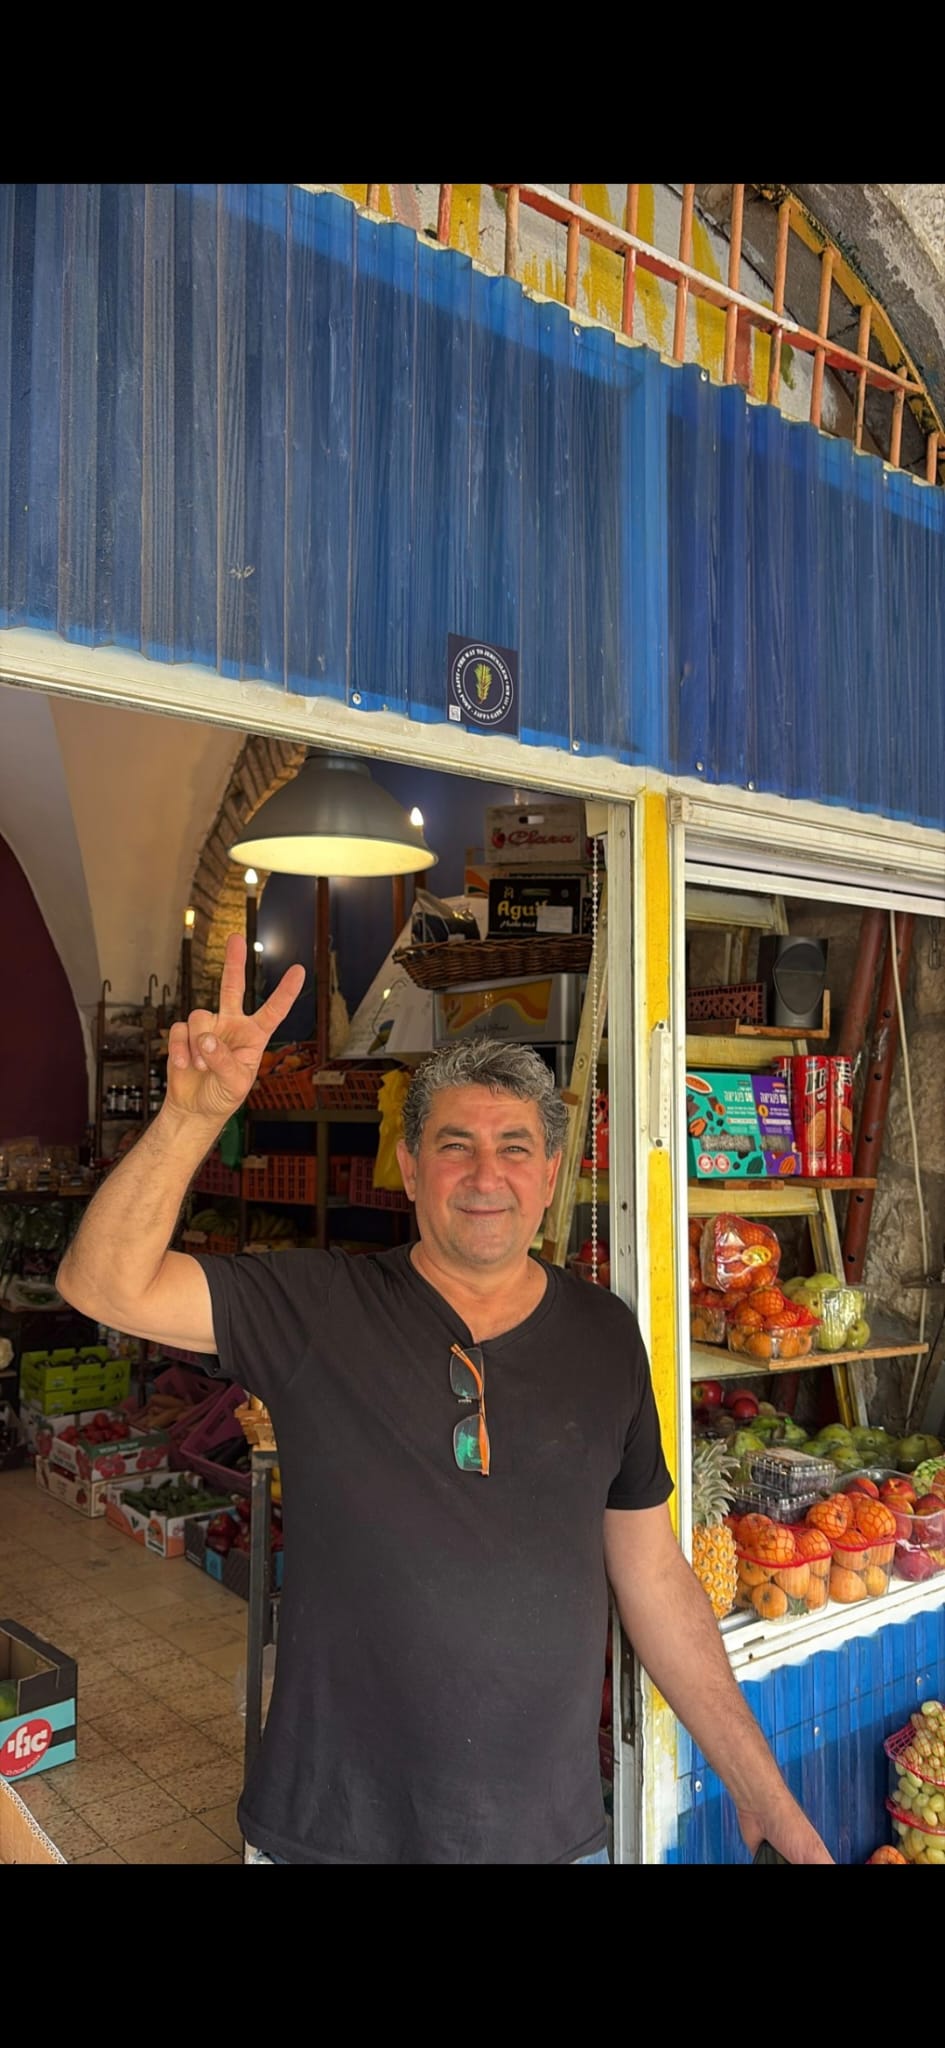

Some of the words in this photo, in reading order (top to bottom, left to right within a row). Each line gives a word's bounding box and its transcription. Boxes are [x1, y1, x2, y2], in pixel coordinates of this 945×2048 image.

[465, 649, 475, 657] WAY
[484, 650, 508, 680] JERUSALEM
[508, 829, 575, 845] Clara
